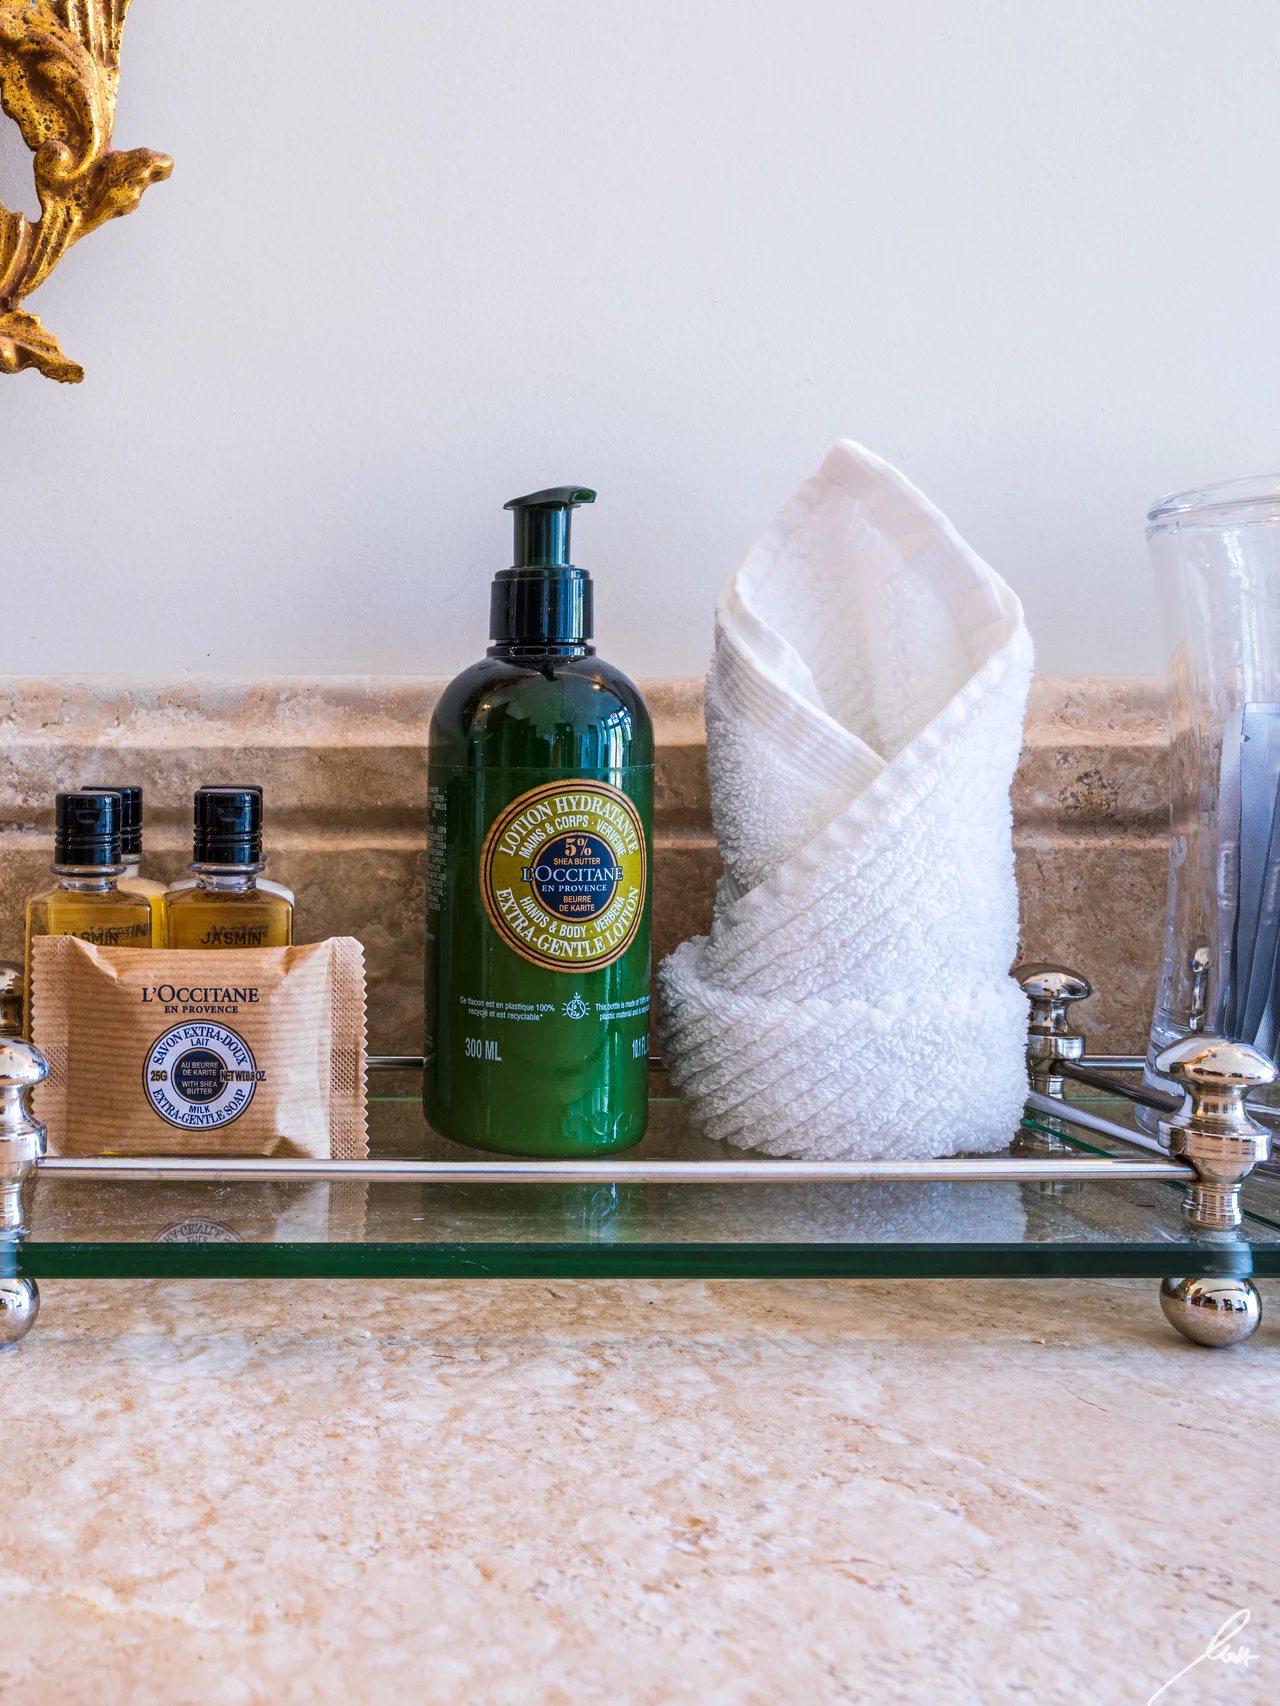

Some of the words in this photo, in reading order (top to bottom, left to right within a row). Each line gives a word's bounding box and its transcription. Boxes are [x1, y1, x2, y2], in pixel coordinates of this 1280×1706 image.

[499, 801, 553, 857] LOTION
[554, 795, 639, 855] HYDRATANTE
[518, 828, 547, 859] MAINS
[545, 823, 555, 835] &
[555, 815, 589, 830] CORPS
[596, 819, 627, 858] VERVEINE
[565, 838, 592, 857] 5%
[553, 858, 573, 866] SHEA
[574, 857, 601, 866] BUTTER
[522, 865, 623, 882] L'OCCITANE
[558, 884, 607, 892] PROVENCE
[559, 904, 569, 912] DE
[570, 904, 595, 912] KARITE
[496, 887, 608, 958] EXTRA-GENTLE
[605, 886, 640, 946] LOTION
[520, 896, 550, 928] HANDS
[549, 921, 558, 933] &
[559, 924, 587, 939] BODY
[593, 895, 626, 933] VERBENA
[200, 931, 262, 945] JASMIN
[141, 984, 260, 1003] L'OCCITANE
[164, 1006, 179, 1014] EN
[182, 1005, 239, 1014] PROVENCE
[460, 995, 467, 1004] Ce
[468, 997, 485, 1007] flacon
[505, 1002, 534, 1012] plastique
[535, 1003, 555, 1012] 100%
[595, 1003, 606, 1011] This
[496, 1011, 506, 1019] est
[152, 1031, 182, 1065] SAVON
[183, 1026, 248, 1066] EXTRA-DOUX
[190, 1038, 210, 1047] LAIT
[465, 1037, 482, 1059] 300
[485, 1040, 502, 1061] ML
[150, 1070, 168, 1081] 25G
[220, 1070, 235, 1082] NET
[200, 1080, 218, 1088] SHEA
[152, 1088, 226, 1125] EXTRA-GENTLE
[224, 1088, 247, 1116] SOAP
[188, 1105, 211, 1114] MILK
